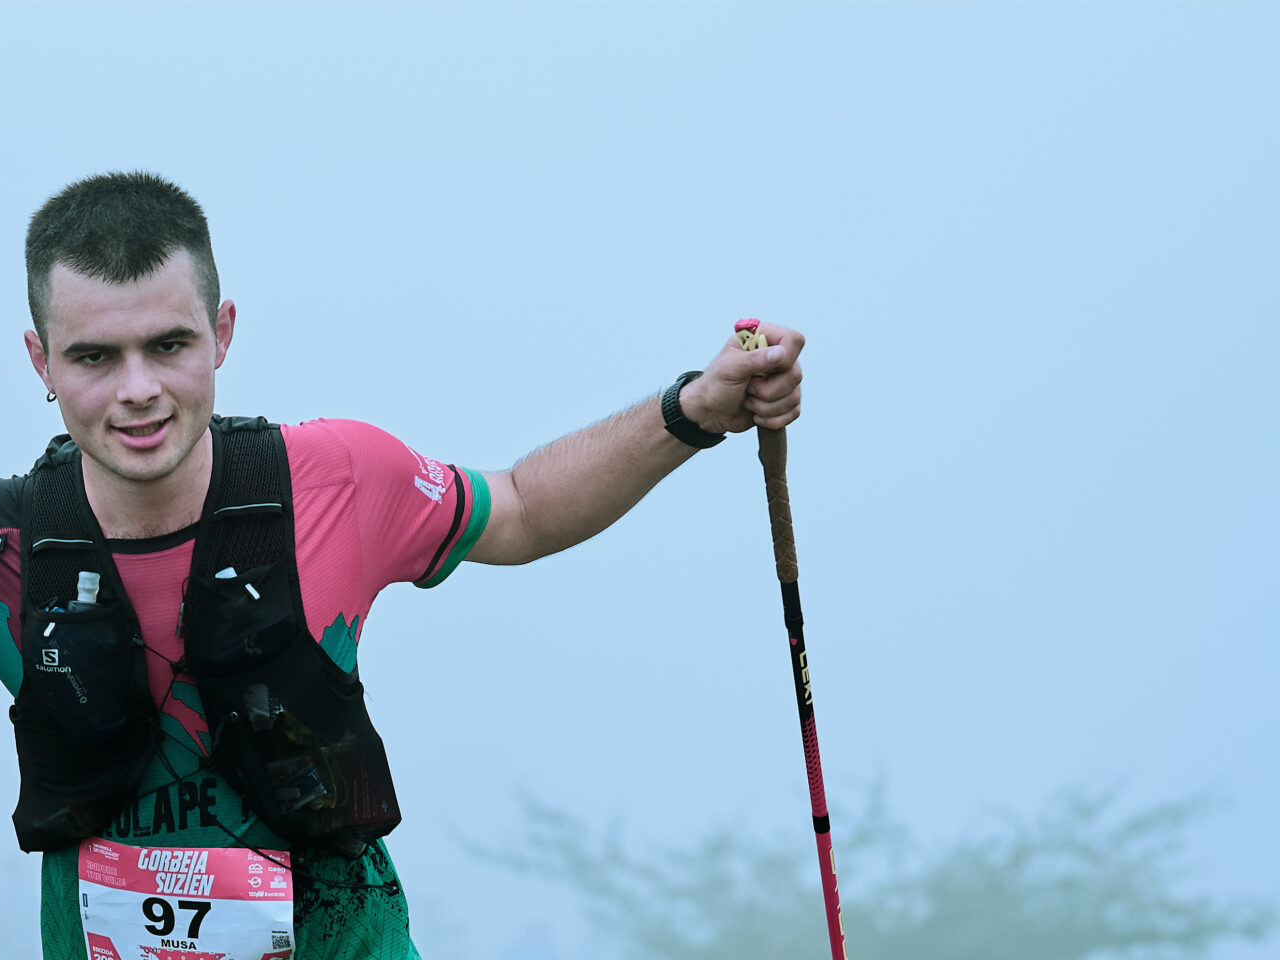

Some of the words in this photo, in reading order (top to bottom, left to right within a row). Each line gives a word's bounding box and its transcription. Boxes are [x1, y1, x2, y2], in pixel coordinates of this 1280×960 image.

[35, 664, 72, 673] salomon
[137, 848, 209, 876] GORBEIA
[155, 872, 215, 896] SUZIEN
[142, 896, 212, 939] 97
[160, 938, 198, 950] MUSA
